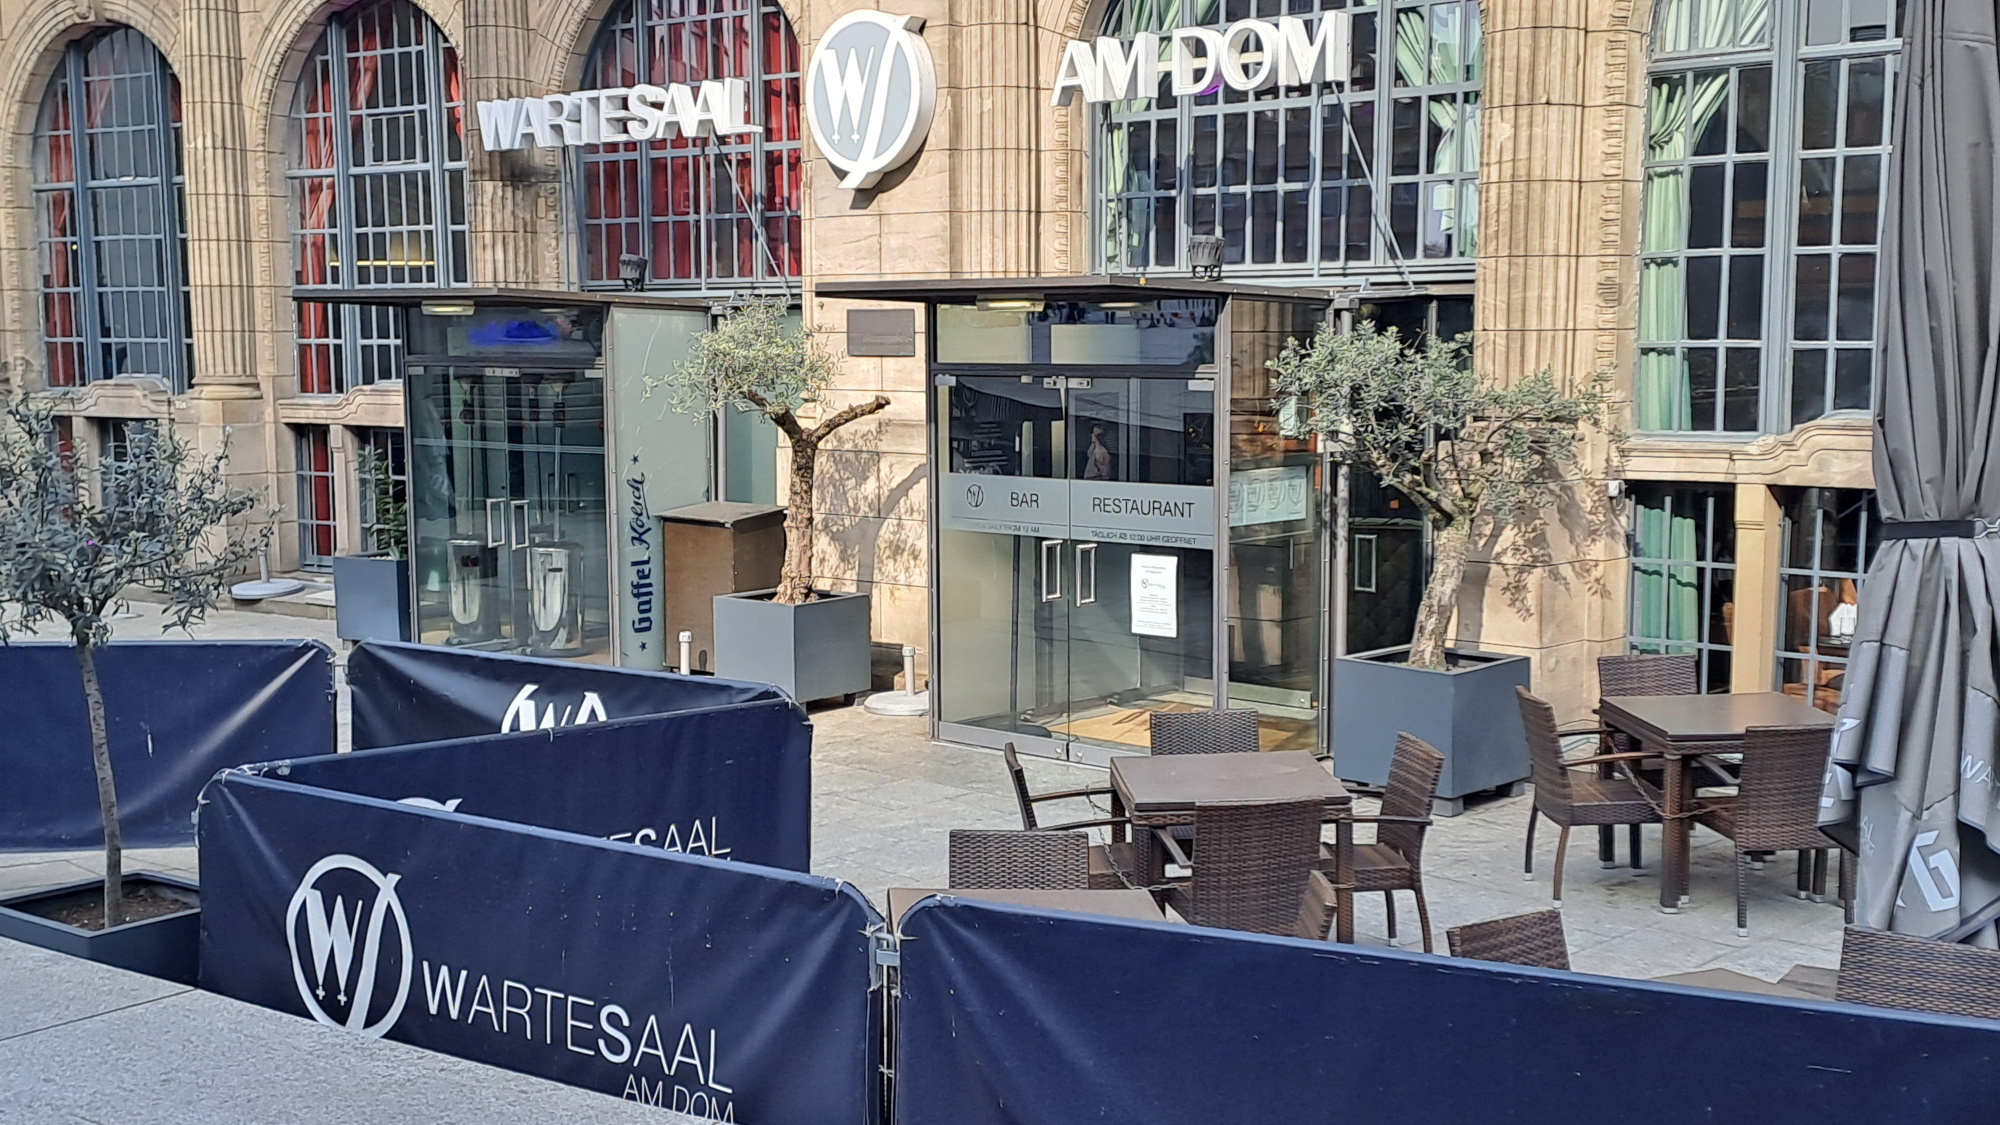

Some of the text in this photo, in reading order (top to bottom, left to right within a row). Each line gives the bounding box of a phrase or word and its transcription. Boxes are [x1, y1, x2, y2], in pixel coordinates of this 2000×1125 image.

[1050, 10, 1348, 106] AM DOM
[476, 77, 763, 151] WARTESAAL
[1010, 492, 1039, 509] BAR
[1092, 497, 1196, 519] RESTAURANT
[631, 556, 653, 633] Gaffel
[422, 960, 733, 1094] WARTESAAL
[623, 1073, 734, 1125] AM DOM
